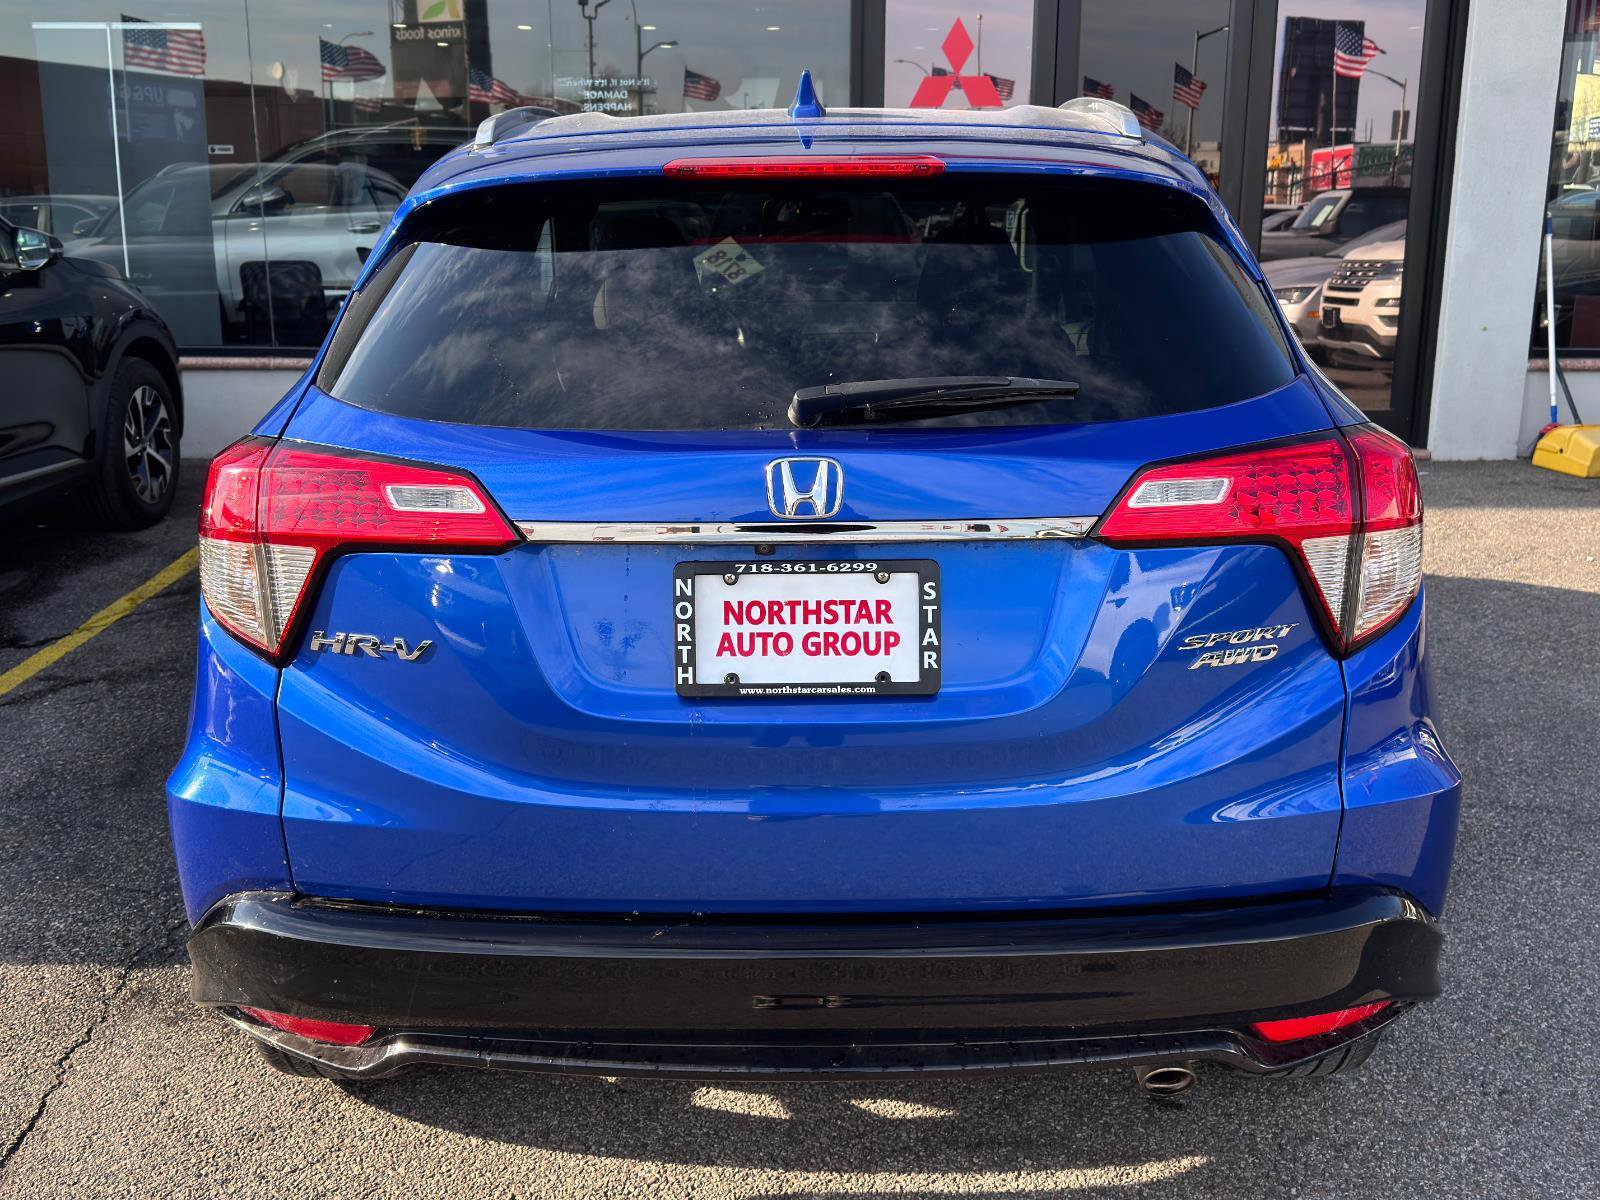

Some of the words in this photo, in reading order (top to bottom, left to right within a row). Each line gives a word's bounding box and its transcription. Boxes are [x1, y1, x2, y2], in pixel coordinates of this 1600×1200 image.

[735, 562, 878, 574] 718-361-6299
[723, 599, 894, 626] NORTHSTAR
[921, 581, 939, 669] STAR
[675, 578, 694, 685] NORTH
[715, 631, 795, 657] AUTO
[801, 630, 901, 657] GROUP
[1178, 622, 1300, 651] SPORT
[310, 630, 433, 661] HR-V
[1188, 644, 1279, 670] AWD
[739, 685, 876, 695] www.northstarcarsales.com
